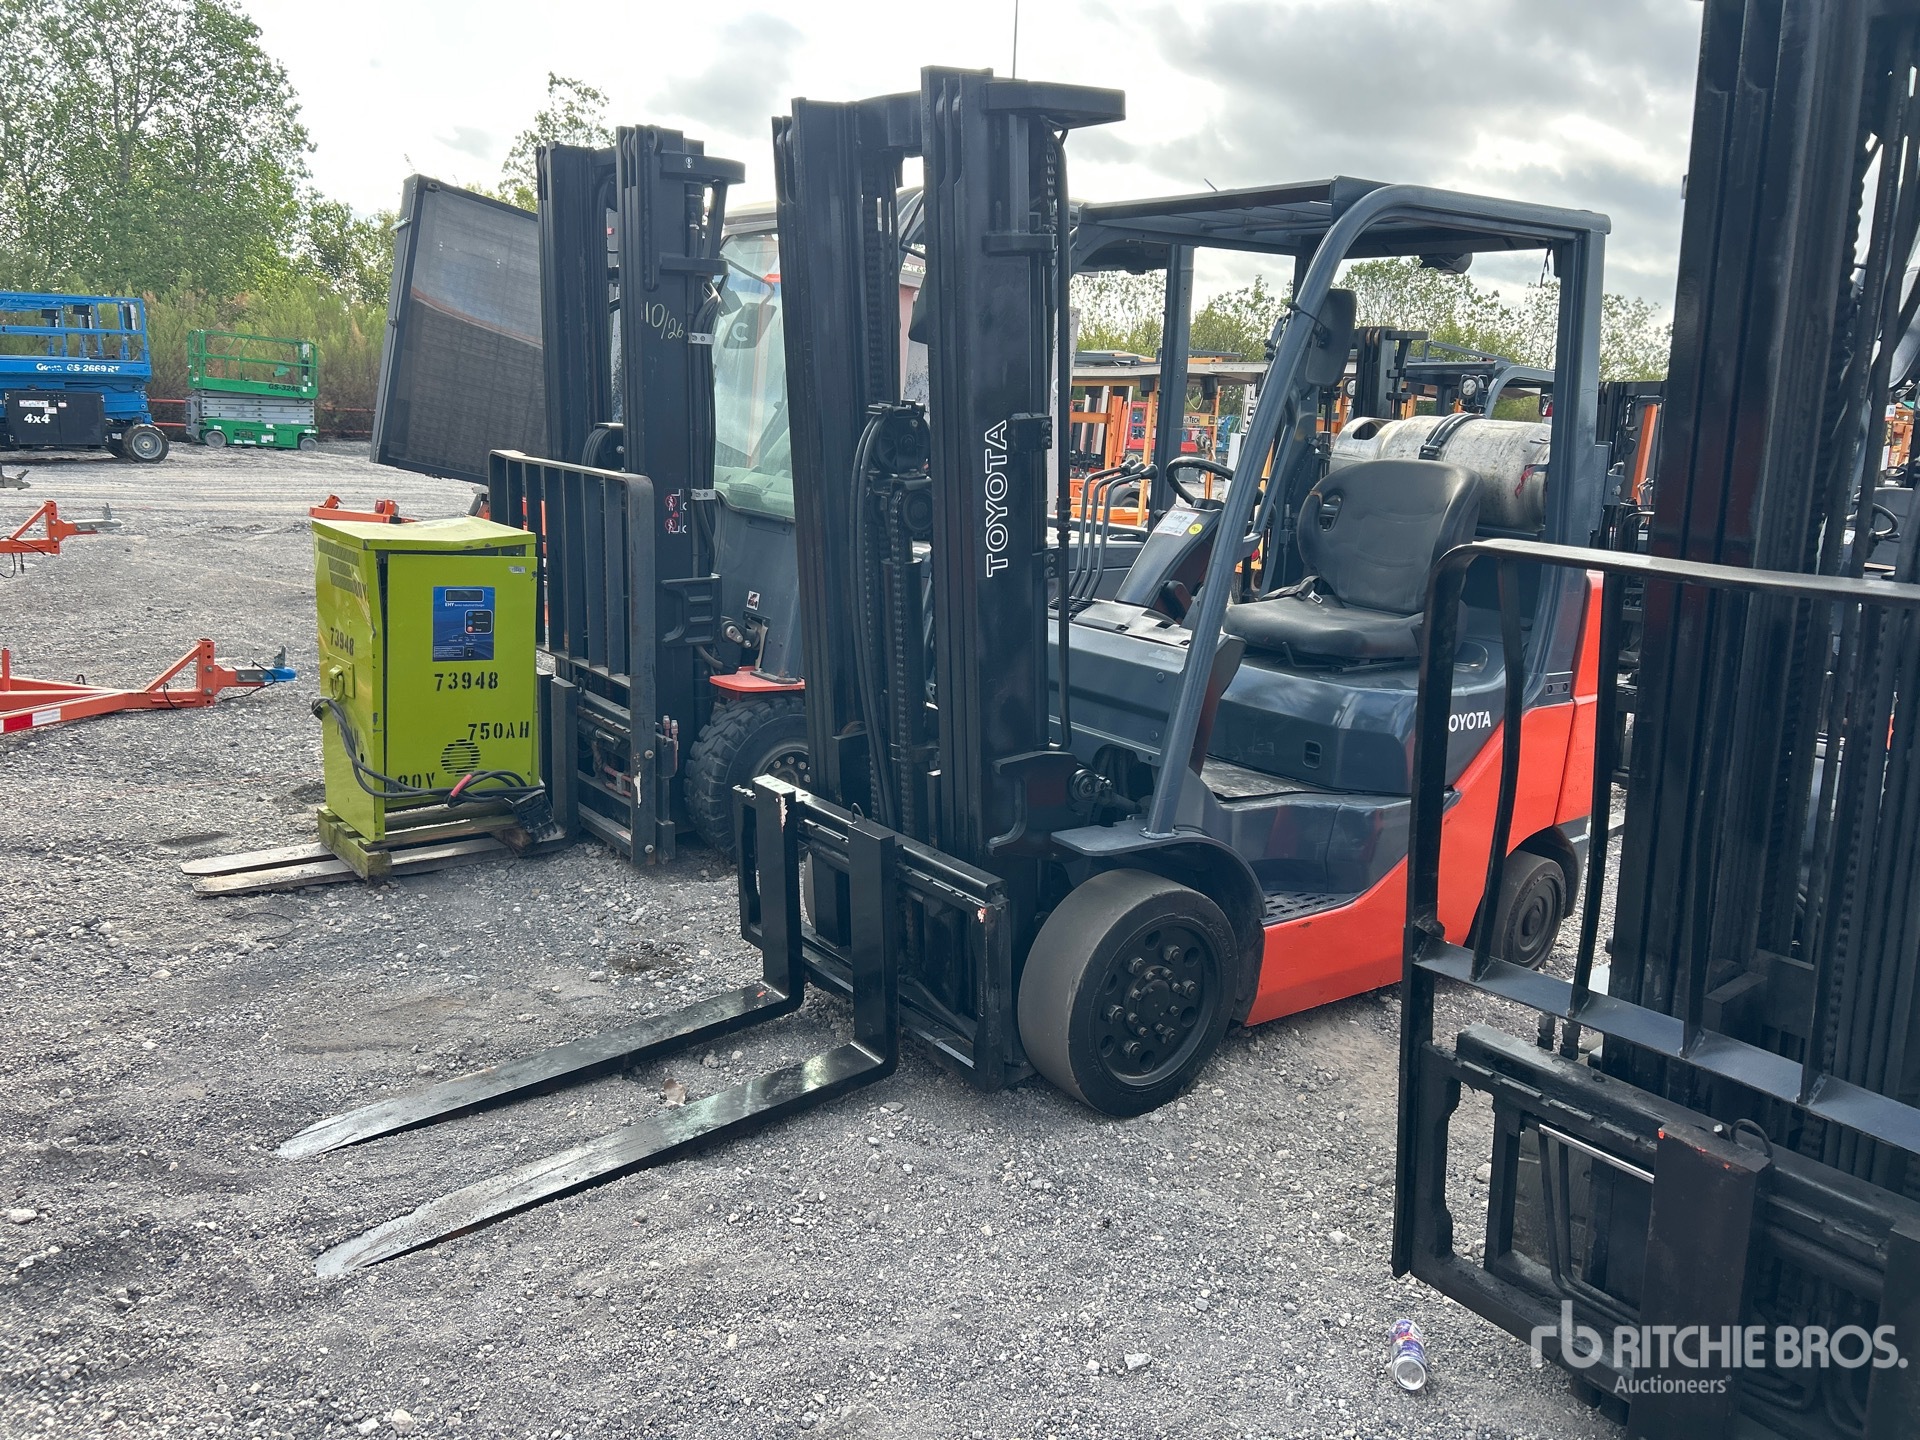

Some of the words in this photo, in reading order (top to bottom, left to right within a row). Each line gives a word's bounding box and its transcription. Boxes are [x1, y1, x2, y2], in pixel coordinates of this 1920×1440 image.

[24, 413, 51, 424] 4x4
[985, 419, 1008, 578] TOYOTA
[330, 627, 355, 656] 73948
[434, 671, 499, 691] 73948
[467, 721, 530, 741] 750AH
[1448, 710, 1491, 733] OYOTA
